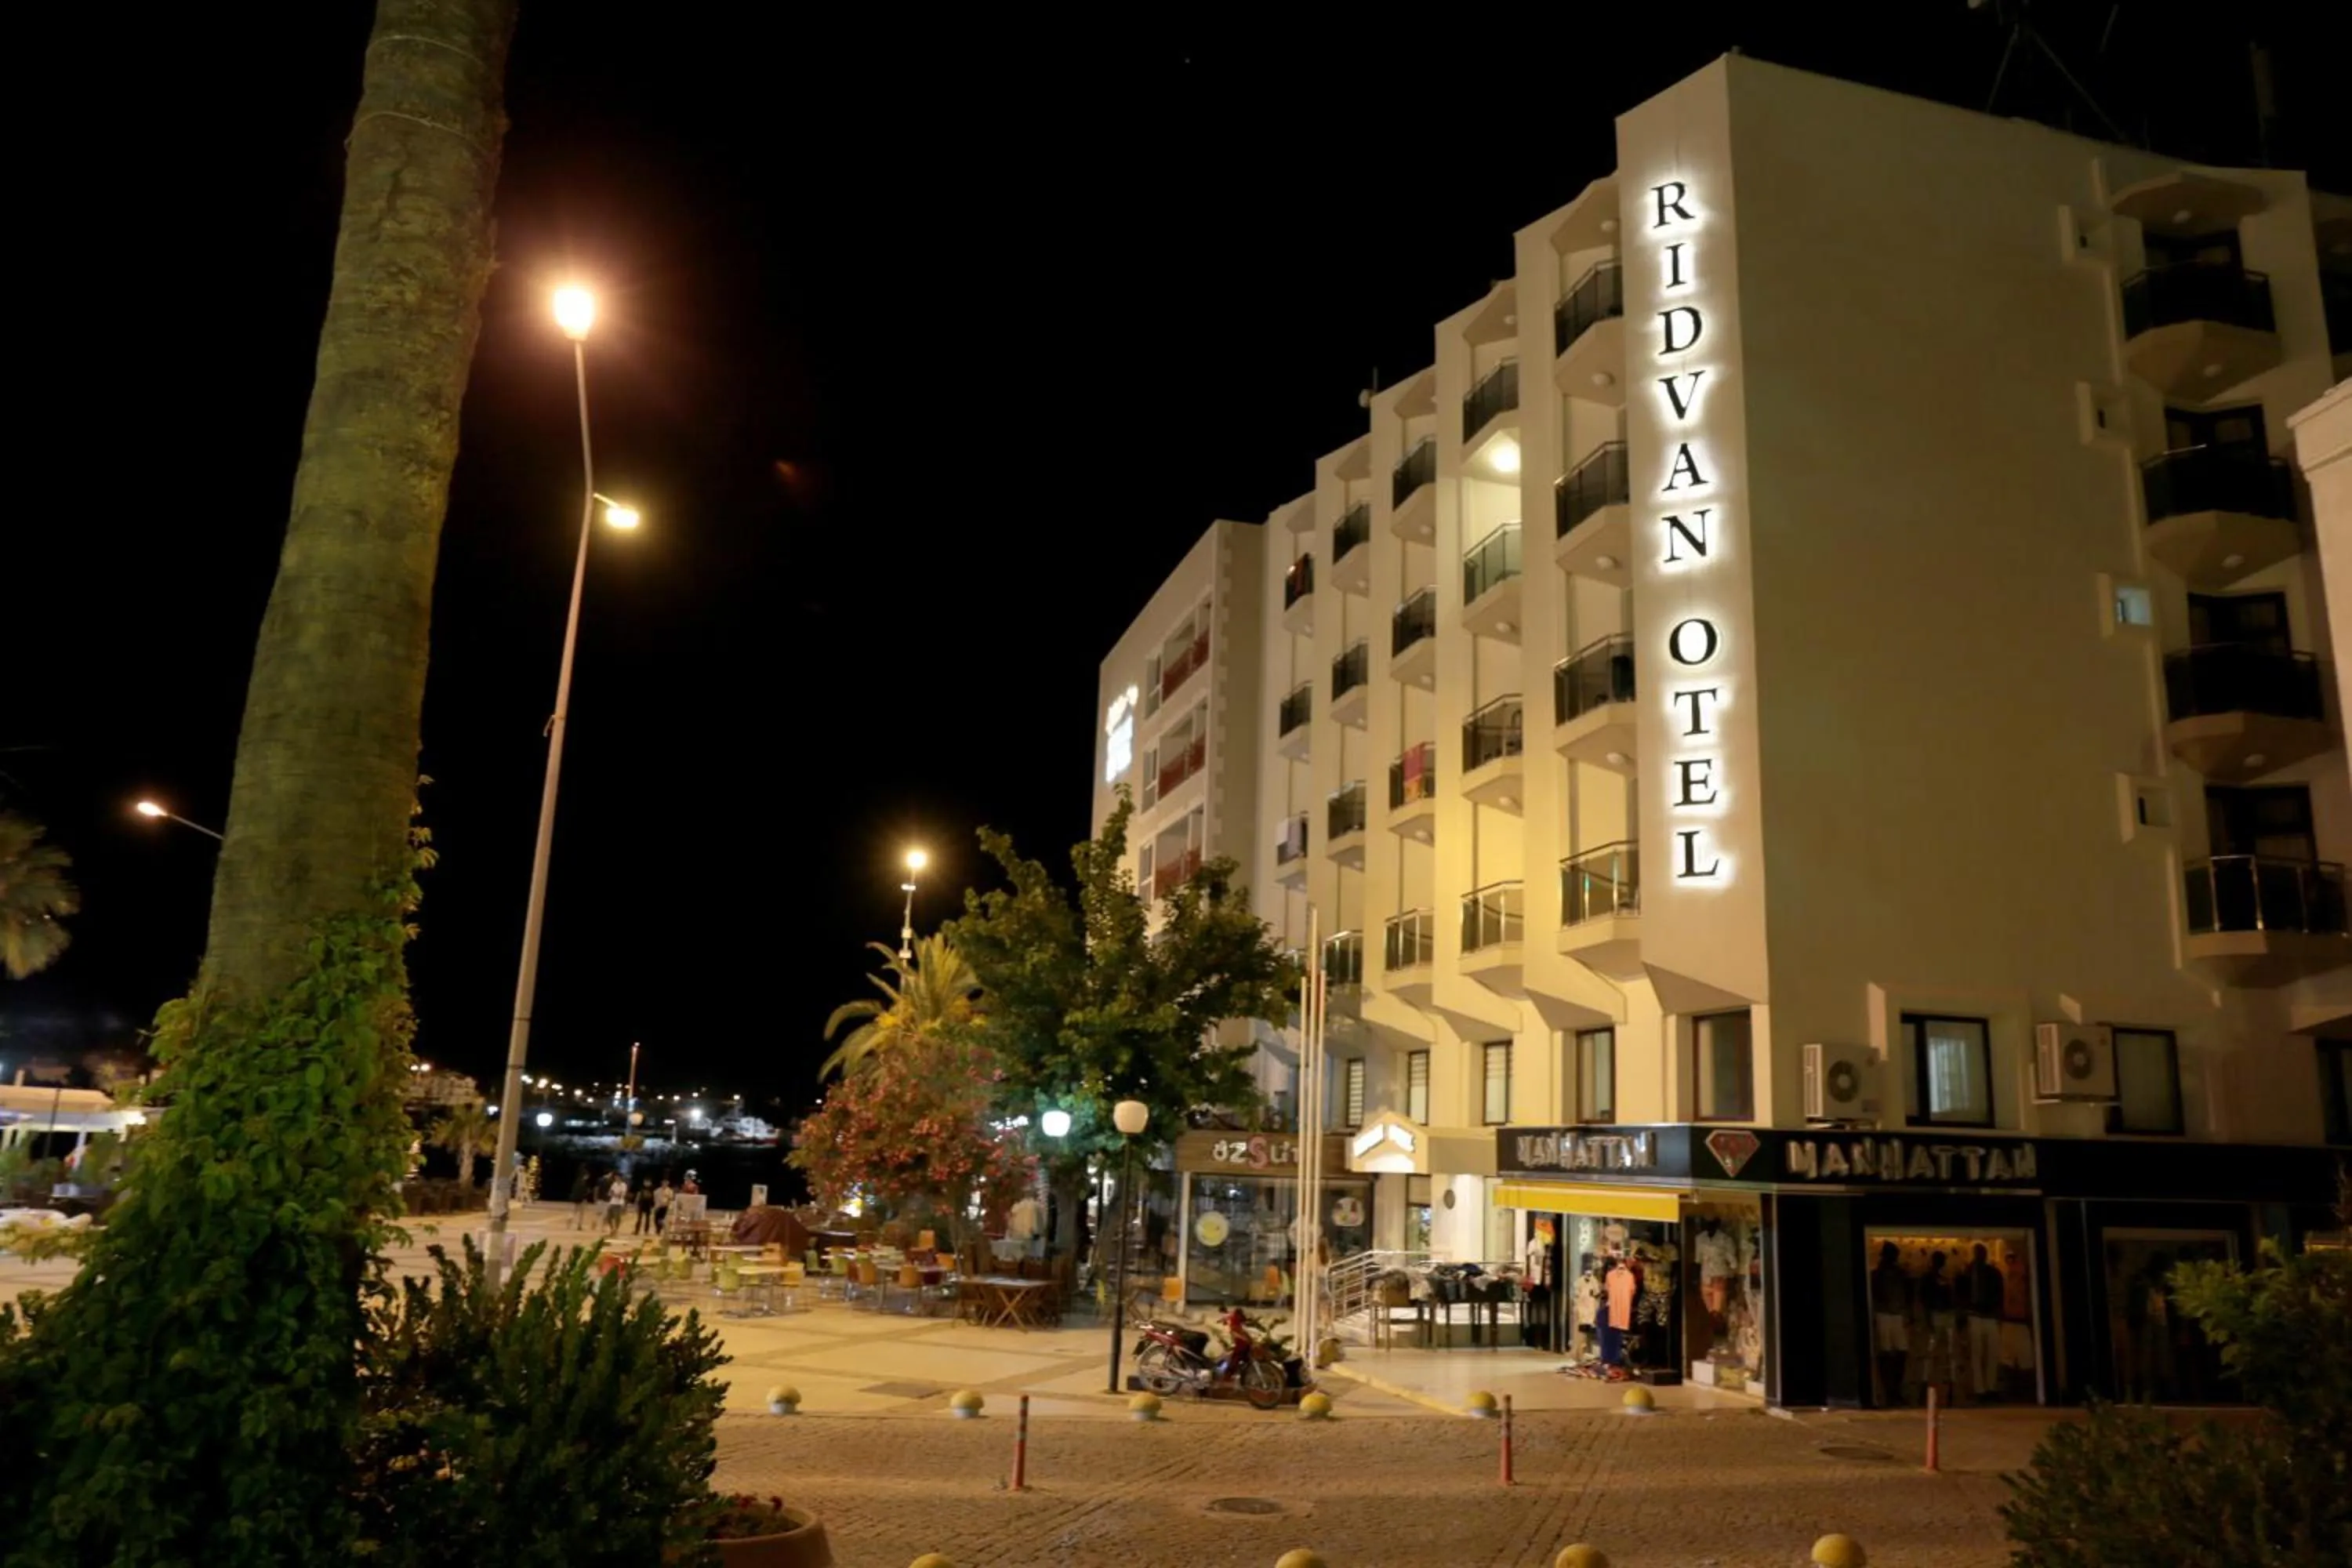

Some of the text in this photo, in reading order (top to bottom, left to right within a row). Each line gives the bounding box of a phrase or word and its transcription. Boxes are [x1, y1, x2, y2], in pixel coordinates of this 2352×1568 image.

[1650, 180, 1719, 878] RIDVAN OTEL
[1517, 1131, 1656, 1169] MANHATTAN
[1786, 1138, 2037, 1180] MANHATTAN
